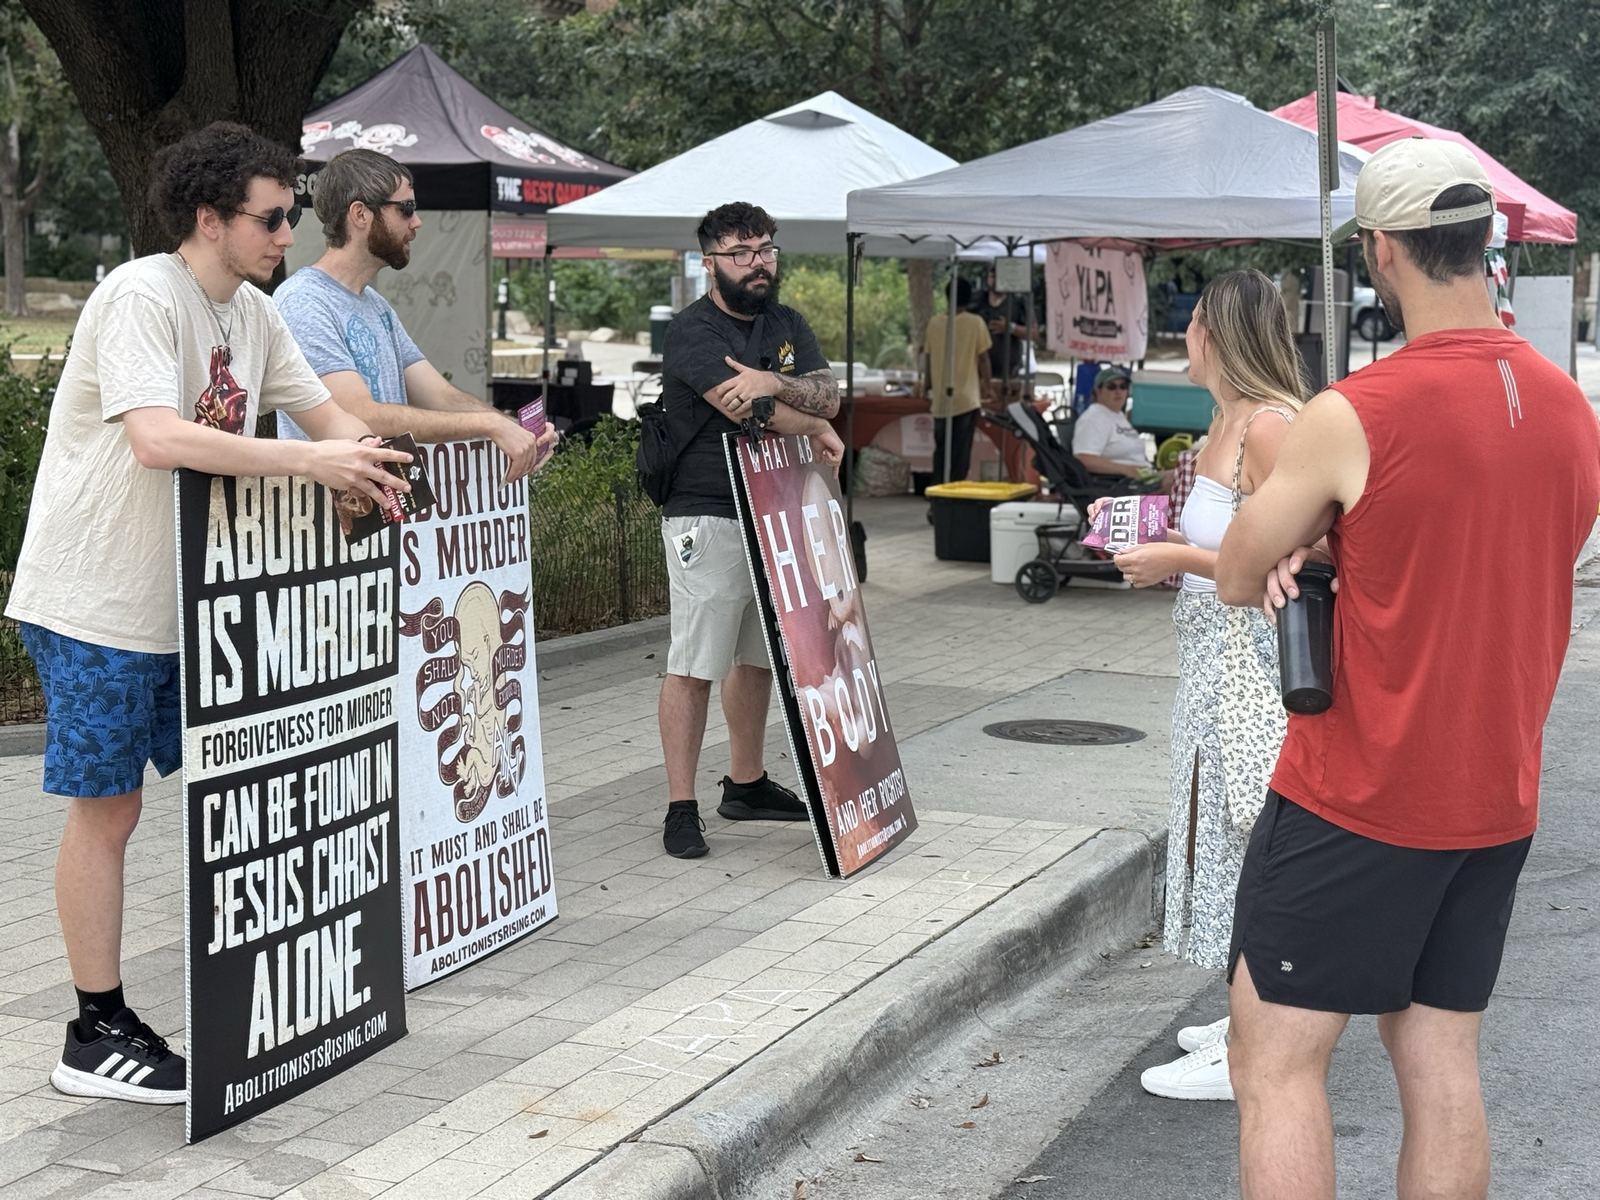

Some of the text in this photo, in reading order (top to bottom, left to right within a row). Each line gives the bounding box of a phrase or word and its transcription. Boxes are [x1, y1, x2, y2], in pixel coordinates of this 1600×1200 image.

[496, 176, 522, 202] THE
[523, 178, 554, 205] BEST
[1076, 264, 1116, 315] YAPA
[402, 440, 525, 524] BORTIO
[746, 437, 790, 473] WHAT
[204, 476, 390, 585] ABORT
[400, 513, 528, 587] S MURDER
[762, 499, 857, 613] HER
[1107, 499, 1132, 547] DER
[197, 567, 393, 709] IS MURDER
[424, 658, 458, 685] SHALL
[431, 620, 454, 649] YOU
[495, 647, 524, 677] MURDER
[201, 686, 393, 770] FORGIVENESS FOR MURDER
[431, 694, 456, 729] NOT
[804, 659, 889, 768] BODY
[203, 783, 260, 863] CAN
[267, 772, 298, 844] BE
[304, 748, 371, 831] FOUND
[375, 739, 393, 804] IN
[410, 797, 544, 876] IT MUST AND SHALL BE
[835, 799, 859, 837] AND
[858, 787, 879, 822] HER
[207, 811, 391, 956] JESUS CHRIST
[413, 827, 552, 958] ABOLISHED
[431, 905, 547, 974] ABOLITIONISTSRISING.COM
[247, 910, 372, 1060] ALONE.
